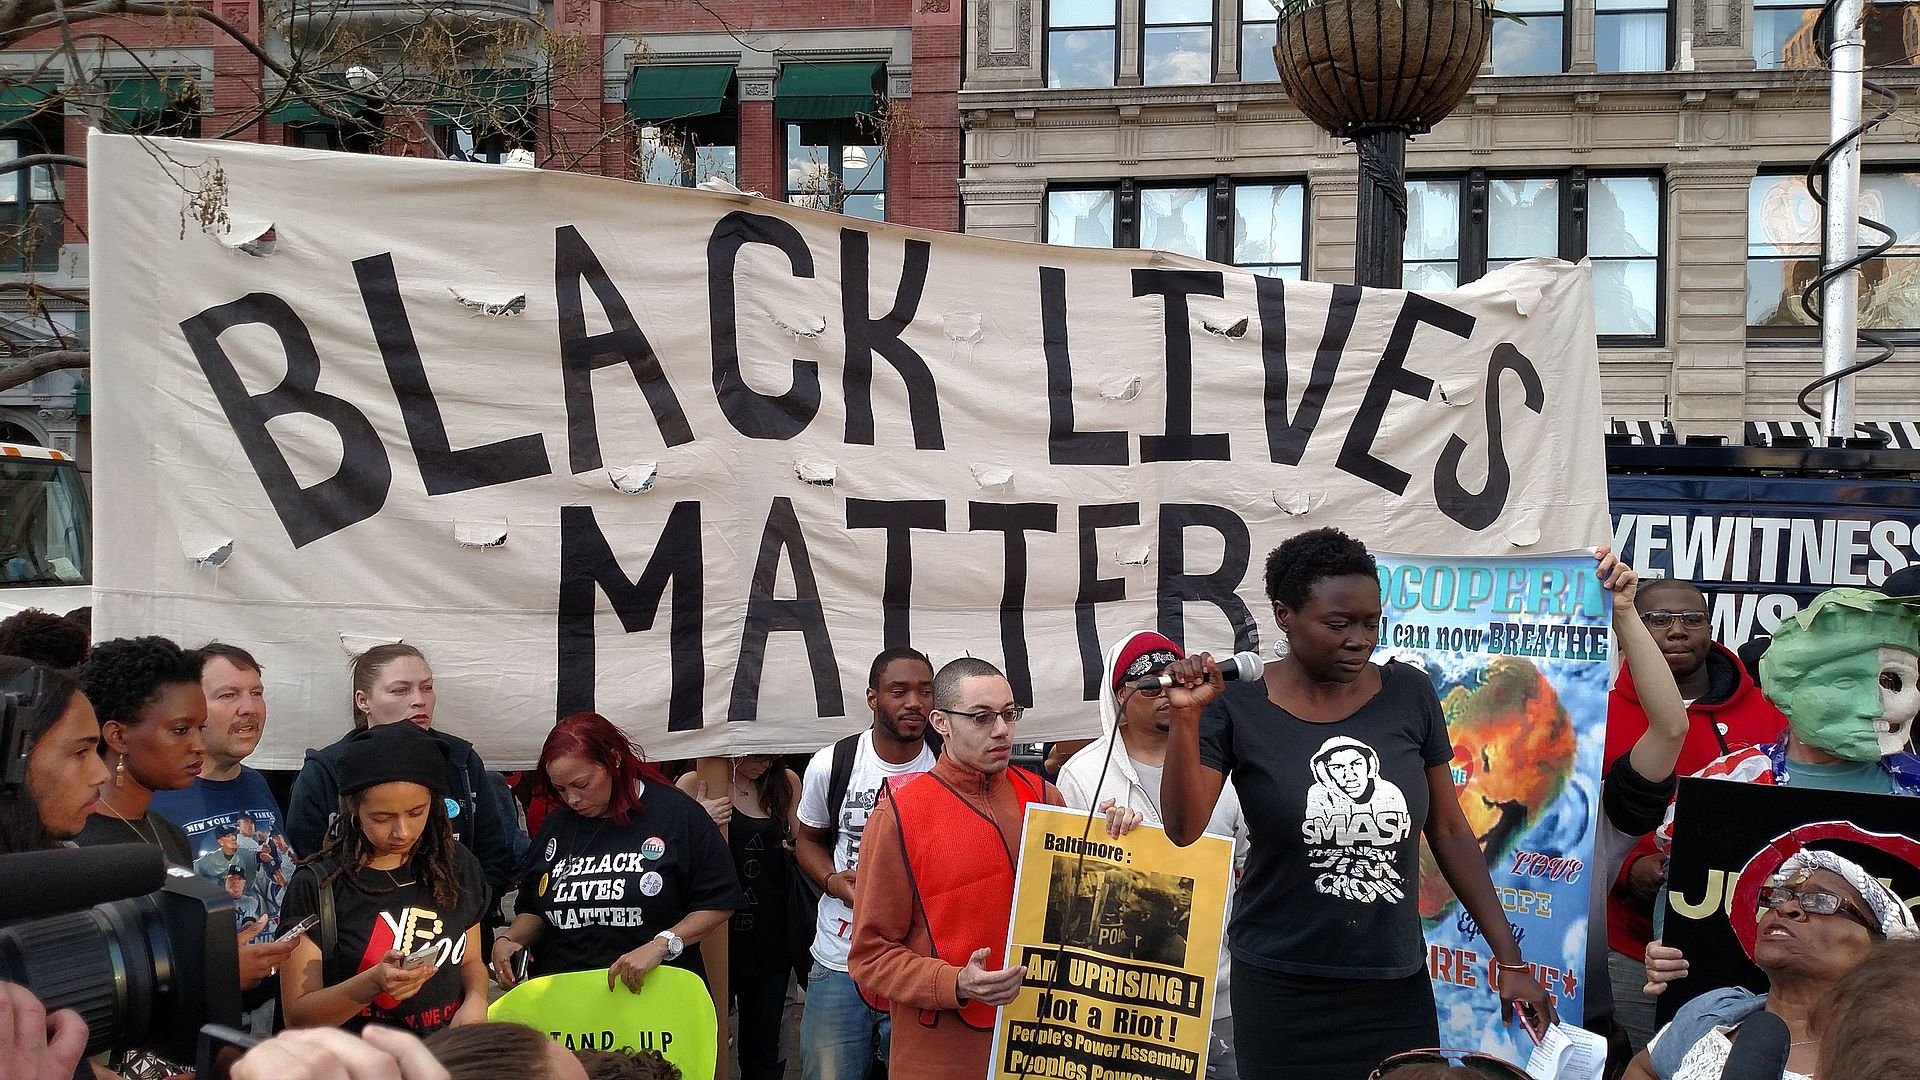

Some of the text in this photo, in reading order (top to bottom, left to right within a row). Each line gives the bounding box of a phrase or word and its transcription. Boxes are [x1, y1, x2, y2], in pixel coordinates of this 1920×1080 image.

[180, 211, 1544, 548] BLACK LIVES
[1610, 513, 1920, 587] YEWITNES
[556, 498, 1260, 732] MATTER
[1702, 592, 1799, 658] WS
[1393, 623, 1430, 649] can
[1435, 625, 1482, 653] now
[1487, 622, 1608, 661] BREATHE
[186, 823, 206, 833] NEW
[207, 816, 231, 827] YORK
[1302, 812, 1412, 845] SMASH
[1044, 833, 1124, 862] Baltimore
[551, 852, 646, 878] #BLACK
[1510, 850, 1584, 884] LOVE
[554, 879, 626, 903] LIVES
[1494, 886, 1553, 918] OPE
[1026, 953, 1057, 983] An
[1068, 959, 1183, 1006] UPRISING
[1036, 992, 1079, 1024] Not
[1087, 1006, 1103, 1030] a
[1112, 1007, 1164, 1041] Riot
[550, 1031, 674, 1053] TAND UP
[1012, 1025, 1195, 1075] People's Power Assembly
[1010, 1051, 1152, 1080] Peoples Pow
